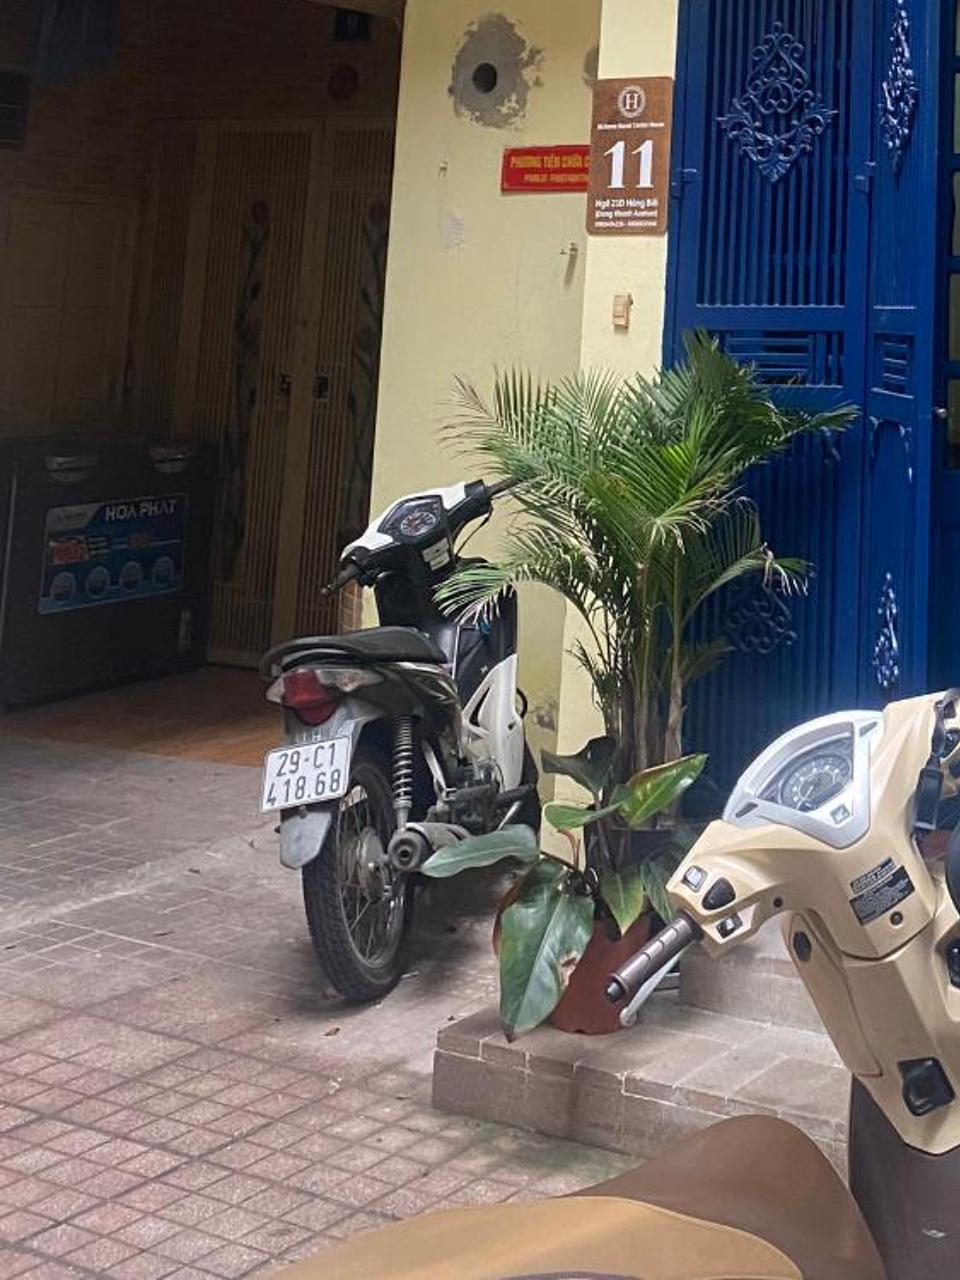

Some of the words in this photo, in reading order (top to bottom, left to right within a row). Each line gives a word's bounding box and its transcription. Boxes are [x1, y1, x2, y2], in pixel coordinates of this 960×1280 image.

[604, 139, 654, 189] 11
[275, 742, 337, 777] 29-C1
[266, 769, 341, 806] 418.68
